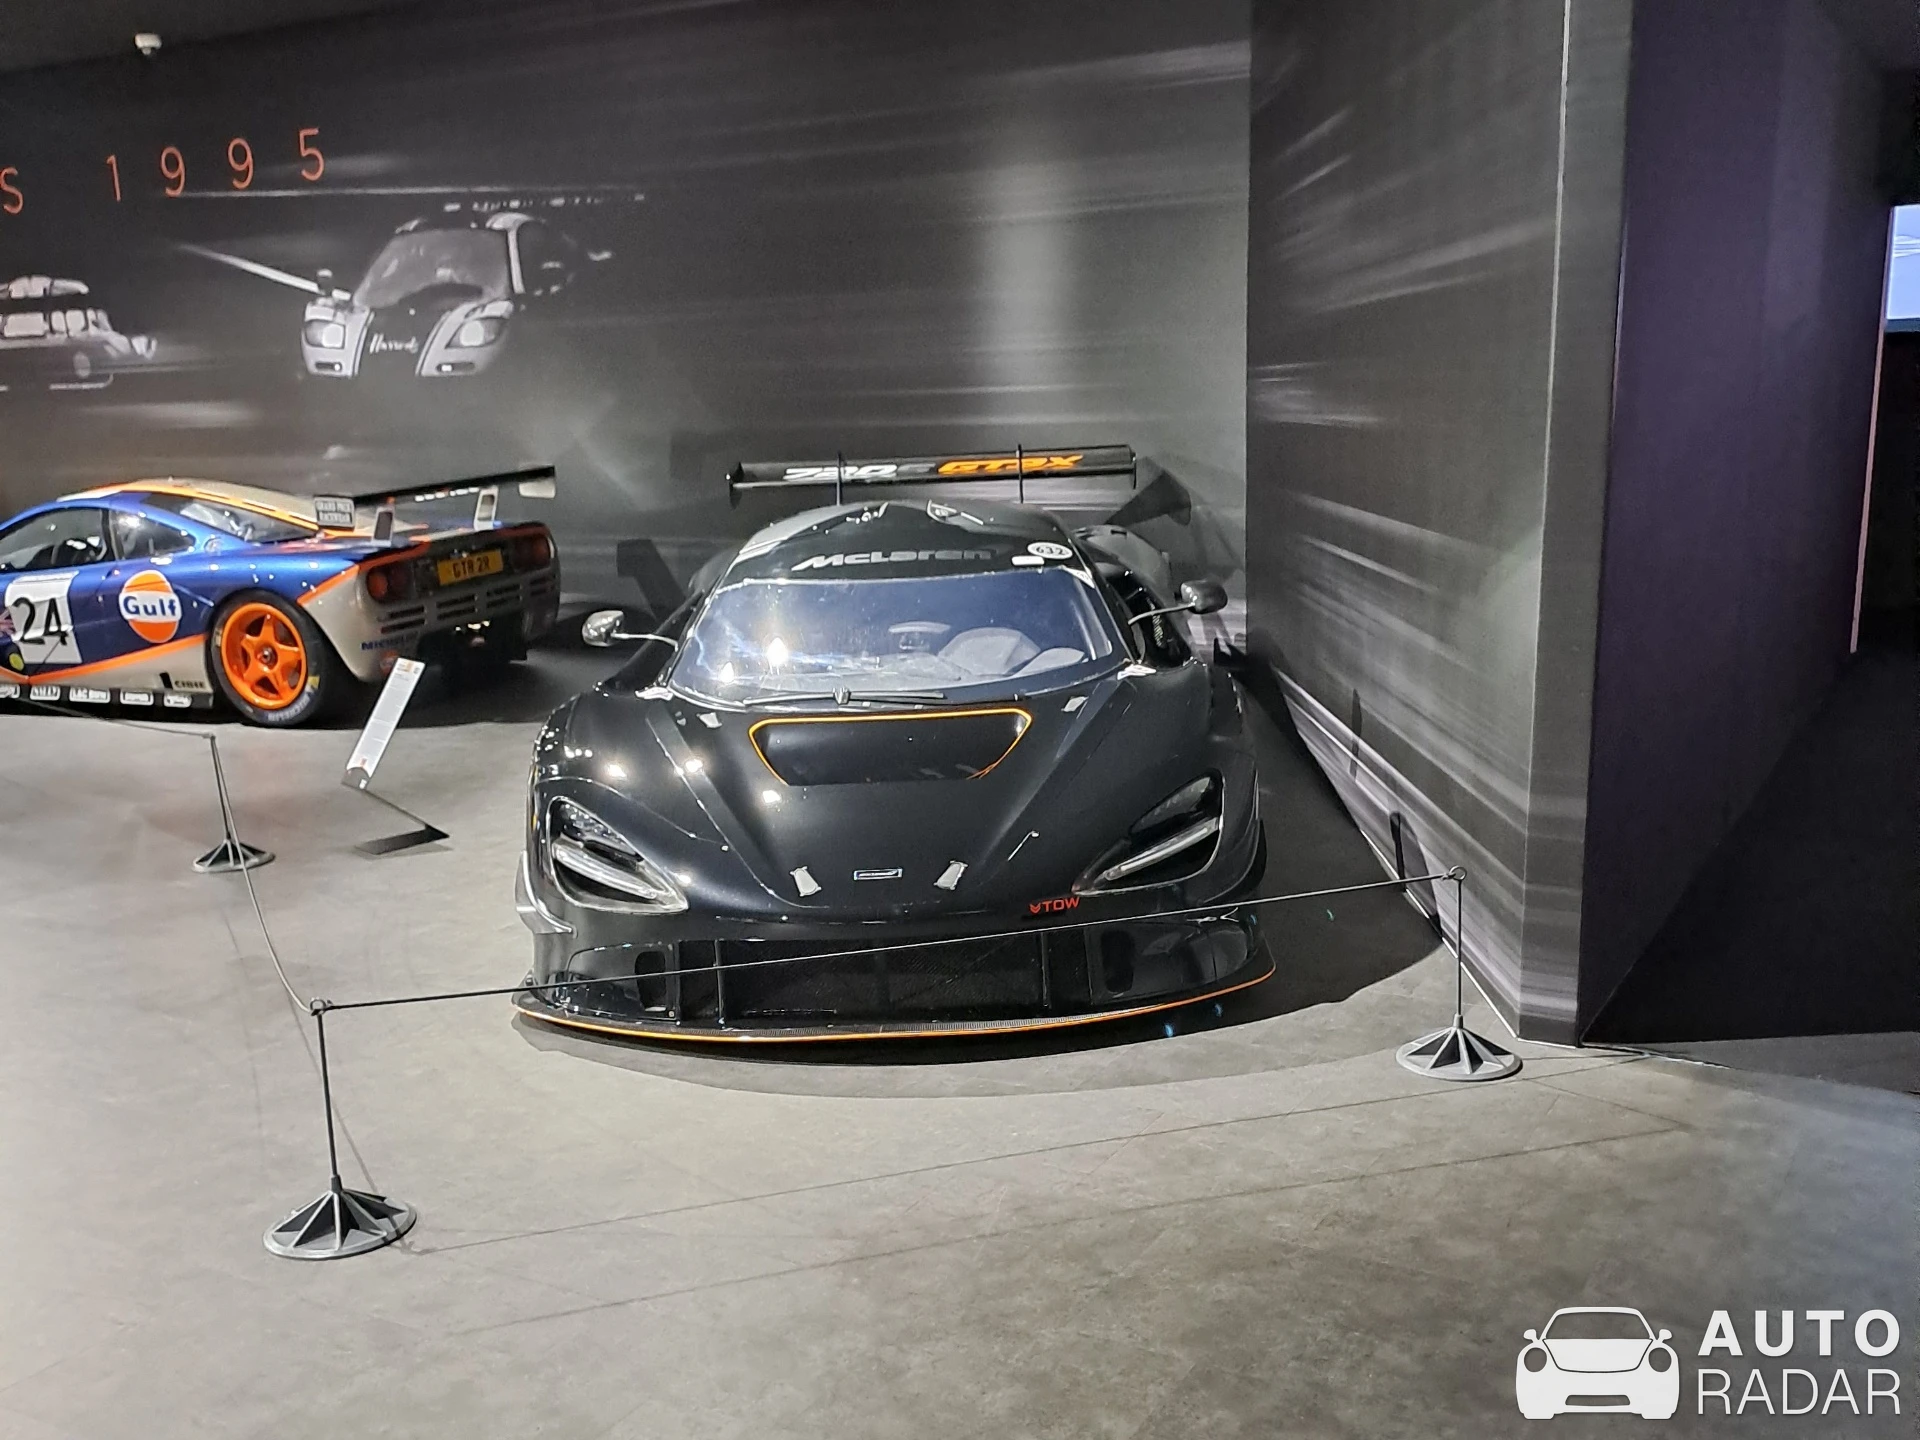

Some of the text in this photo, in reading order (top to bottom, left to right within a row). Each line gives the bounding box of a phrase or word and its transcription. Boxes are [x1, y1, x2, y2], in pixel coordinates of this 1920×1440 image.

[0, 127, 325, 214] S 1995
[13, 597, 68, 646] 24
[123, 595, 178, 617] Gulf
[1043, 897, 1081, 912] TOW
